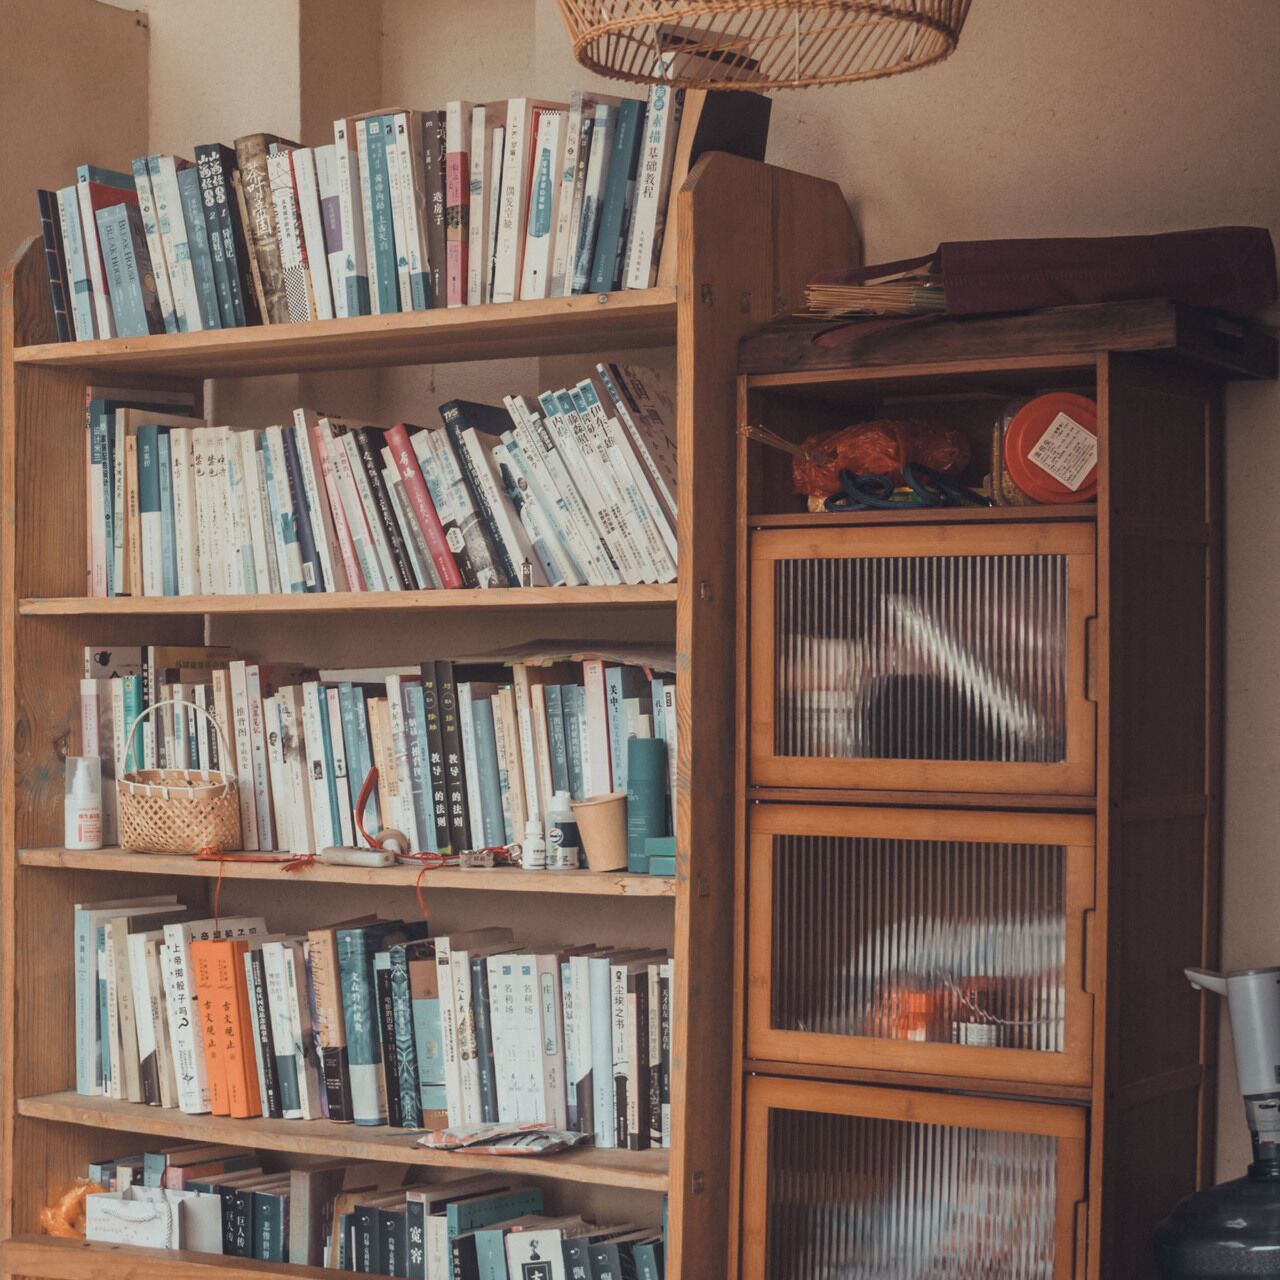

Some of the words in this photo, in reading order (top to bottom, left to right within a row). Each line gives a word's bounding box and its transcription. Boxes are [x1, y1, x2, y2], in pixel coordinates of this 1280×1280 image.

[432, 191, 445, 226] 造房子
[118, 219, 131, 248] BLEAK
[124, 248, 135, 283] HOUSE
[448, 753, 463, 827] 教导一的法则
[504, 983, 514, 1015] 名利场
[523, 983, 534, 1015] 名利场
[614, 984, 625, 1031] 尘埃之书
[222, 1001, 235, 1050] 古文观止
[237, 1215, 246, 1248] 巨人传
[409, 1225, 423, 1265] 宽容
